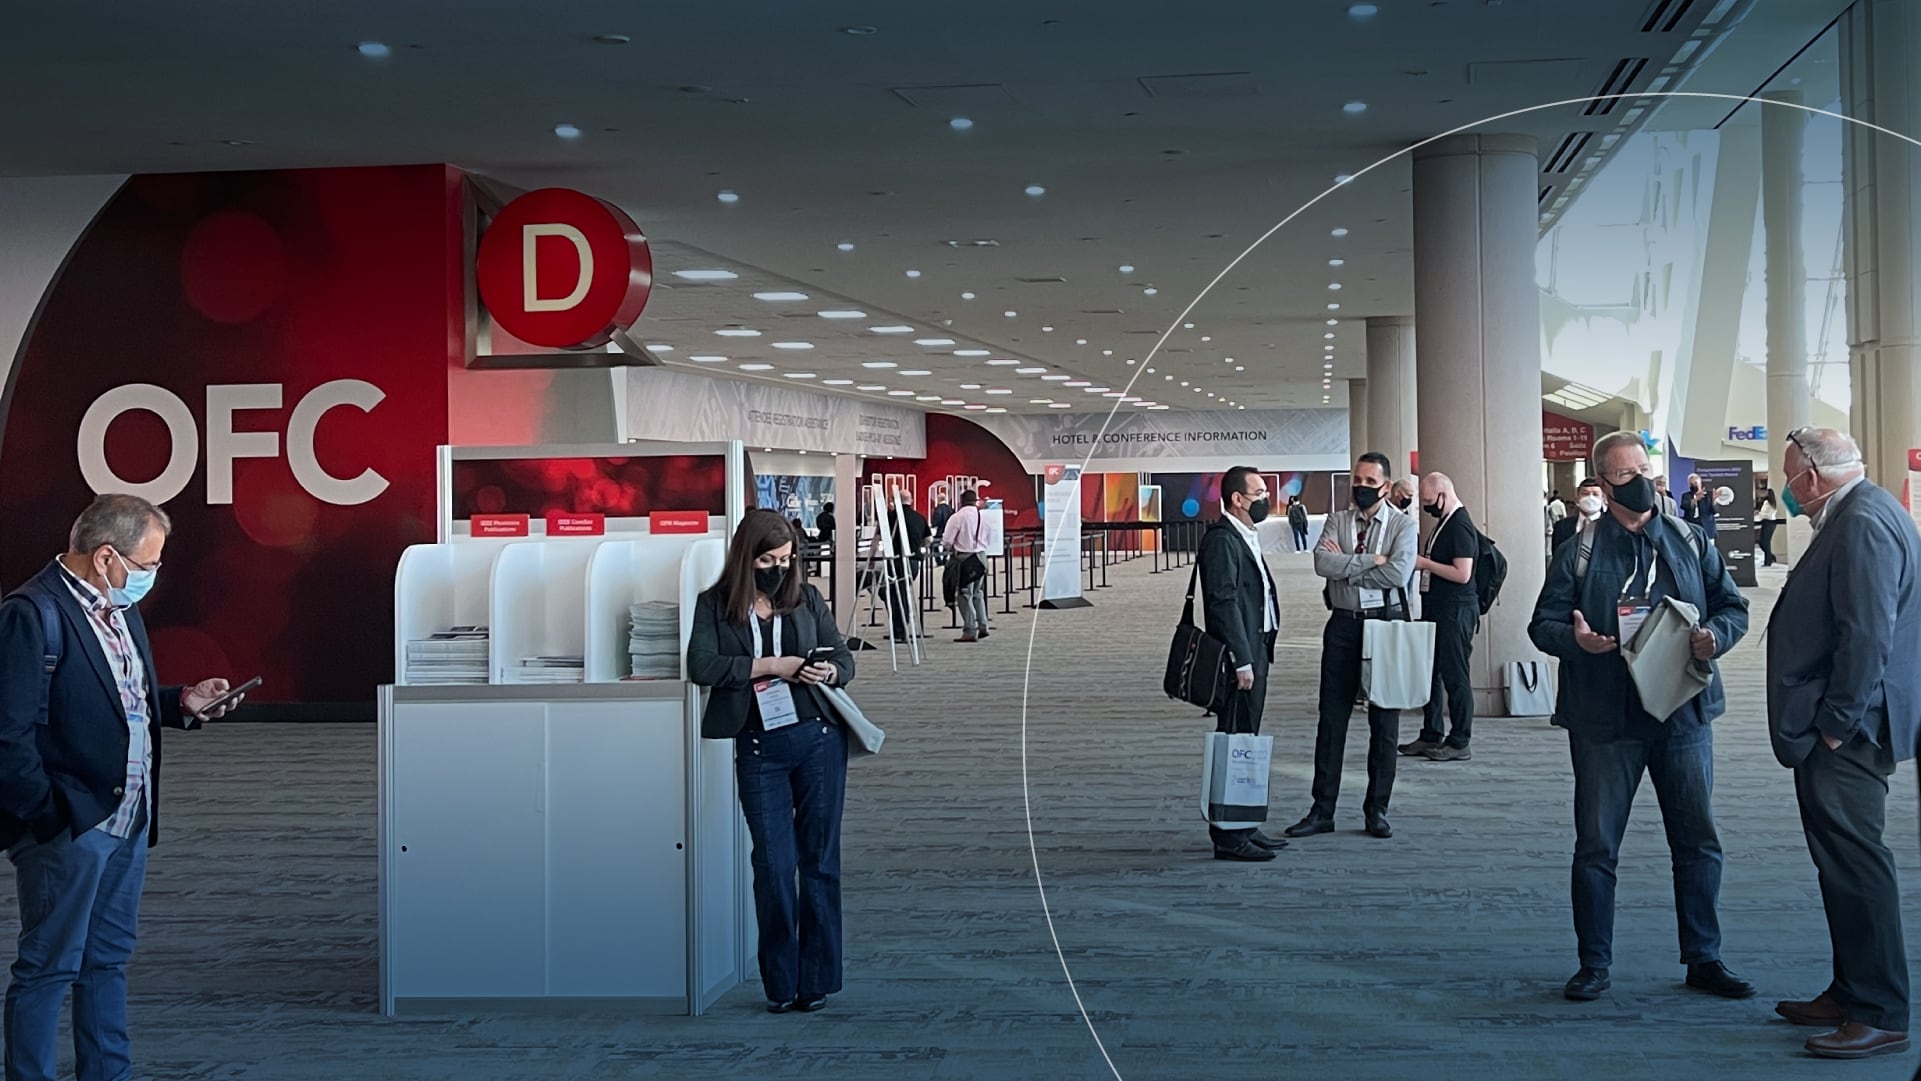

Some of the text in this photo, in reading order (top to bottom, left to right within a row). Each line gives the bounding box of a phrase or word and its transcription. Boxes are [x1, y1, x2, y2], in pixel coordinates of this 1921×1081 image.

[523, 223, 594, 312] D
[1052, 430, 1267, 445] HOTEL & CONFERENCE INFORMATION
[1728, 426, 1768, 440] FedE
[77, 380, 390, 506] OFC
[1231, 749, 1252, 759] OFC
